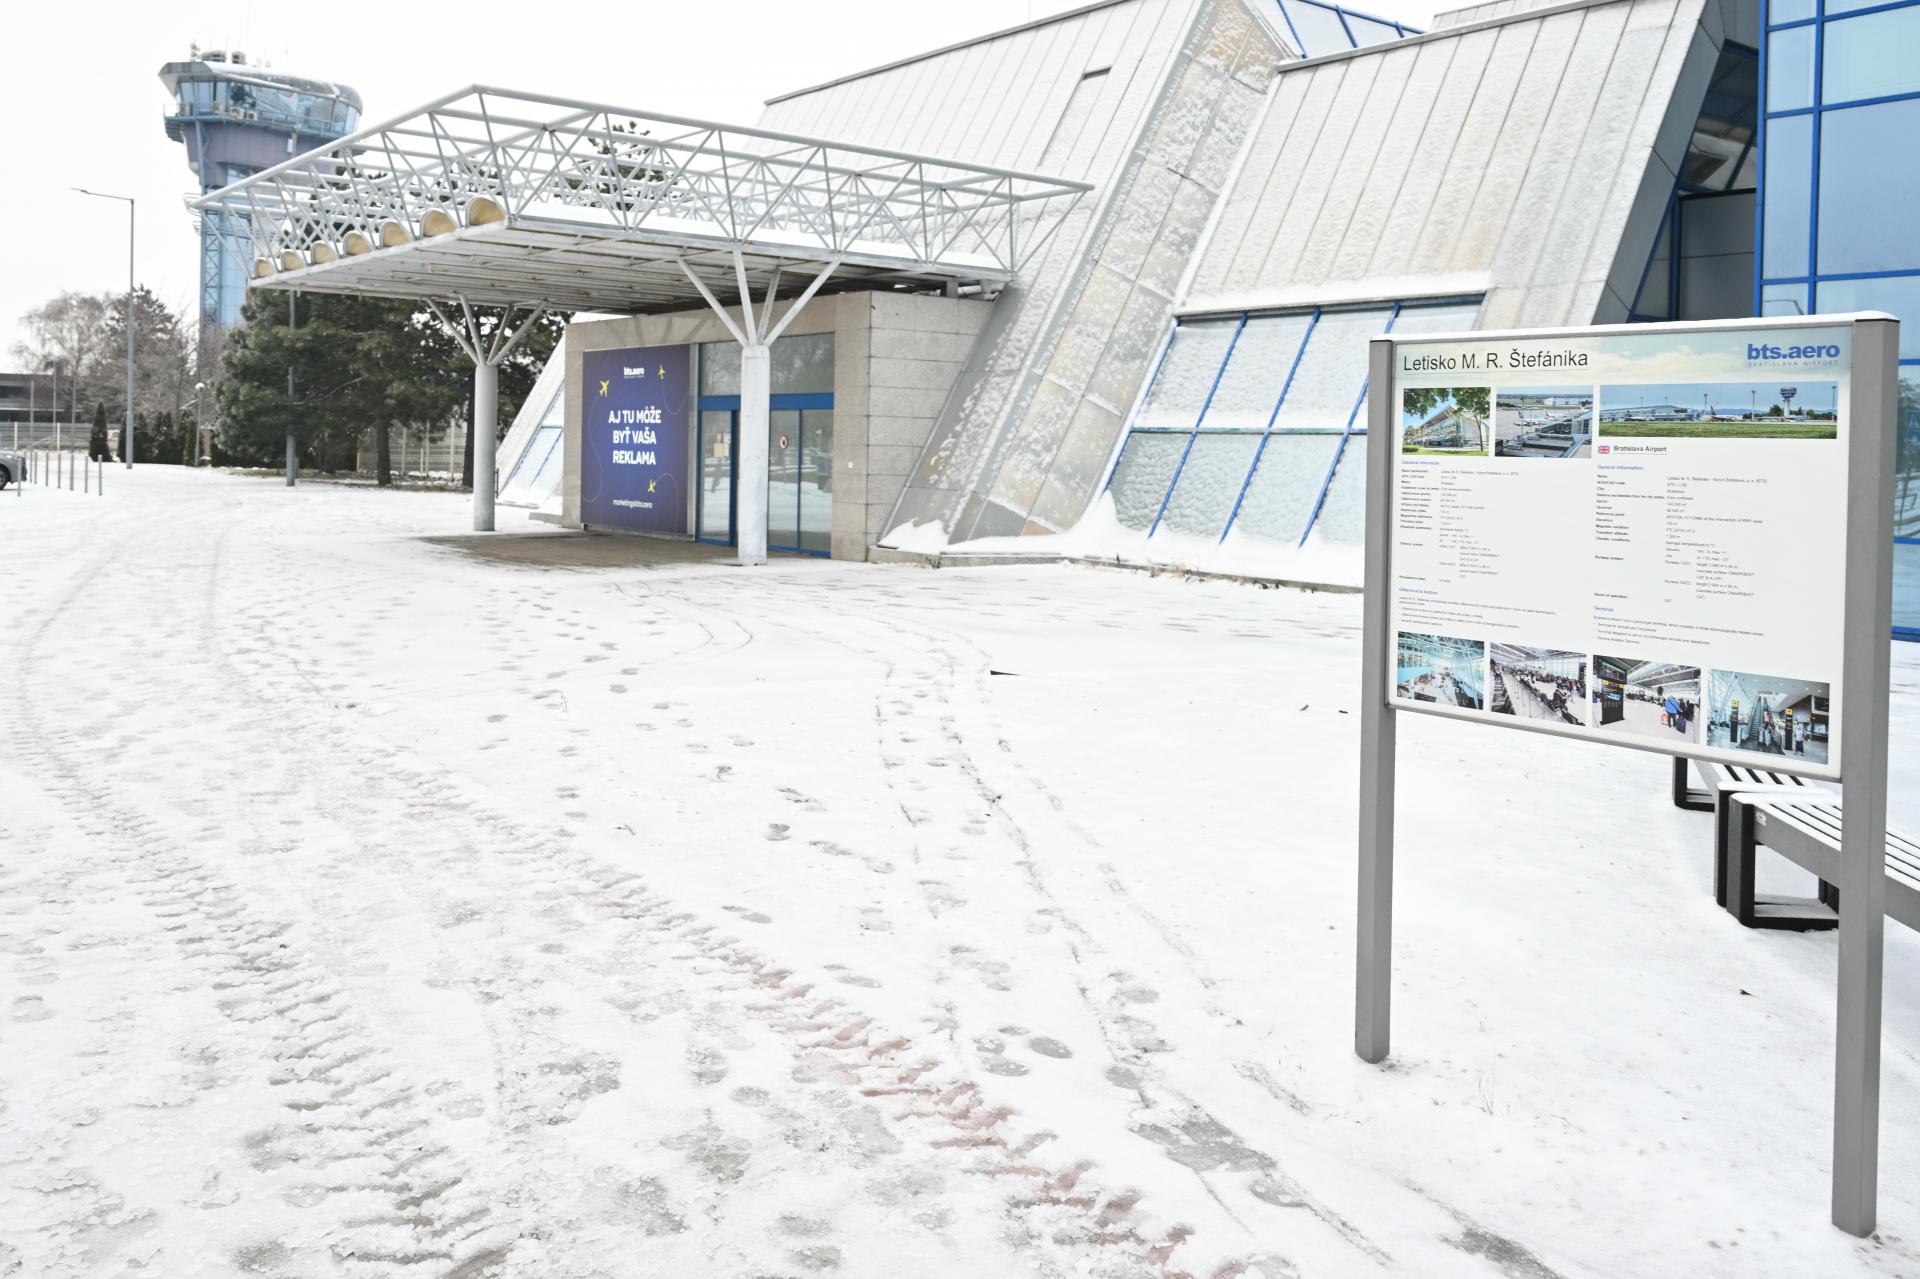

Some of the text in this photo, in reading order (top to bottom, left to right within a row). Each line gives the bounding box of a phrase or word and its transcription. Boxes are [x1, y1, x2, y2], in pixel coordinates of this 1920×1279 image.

[1403, 348, 1588, 371] Letisko M. R. Štefánika
[1747, 343, 1840, 360] bts.aero
[608, 405, 662, 424] AJ TU MÔŽE
[613, 426, 656, 444] BYŤ VAŠA
[613, 450, 656, 465] REKLAMA
[1645, 445, 1667, 453] Airport
